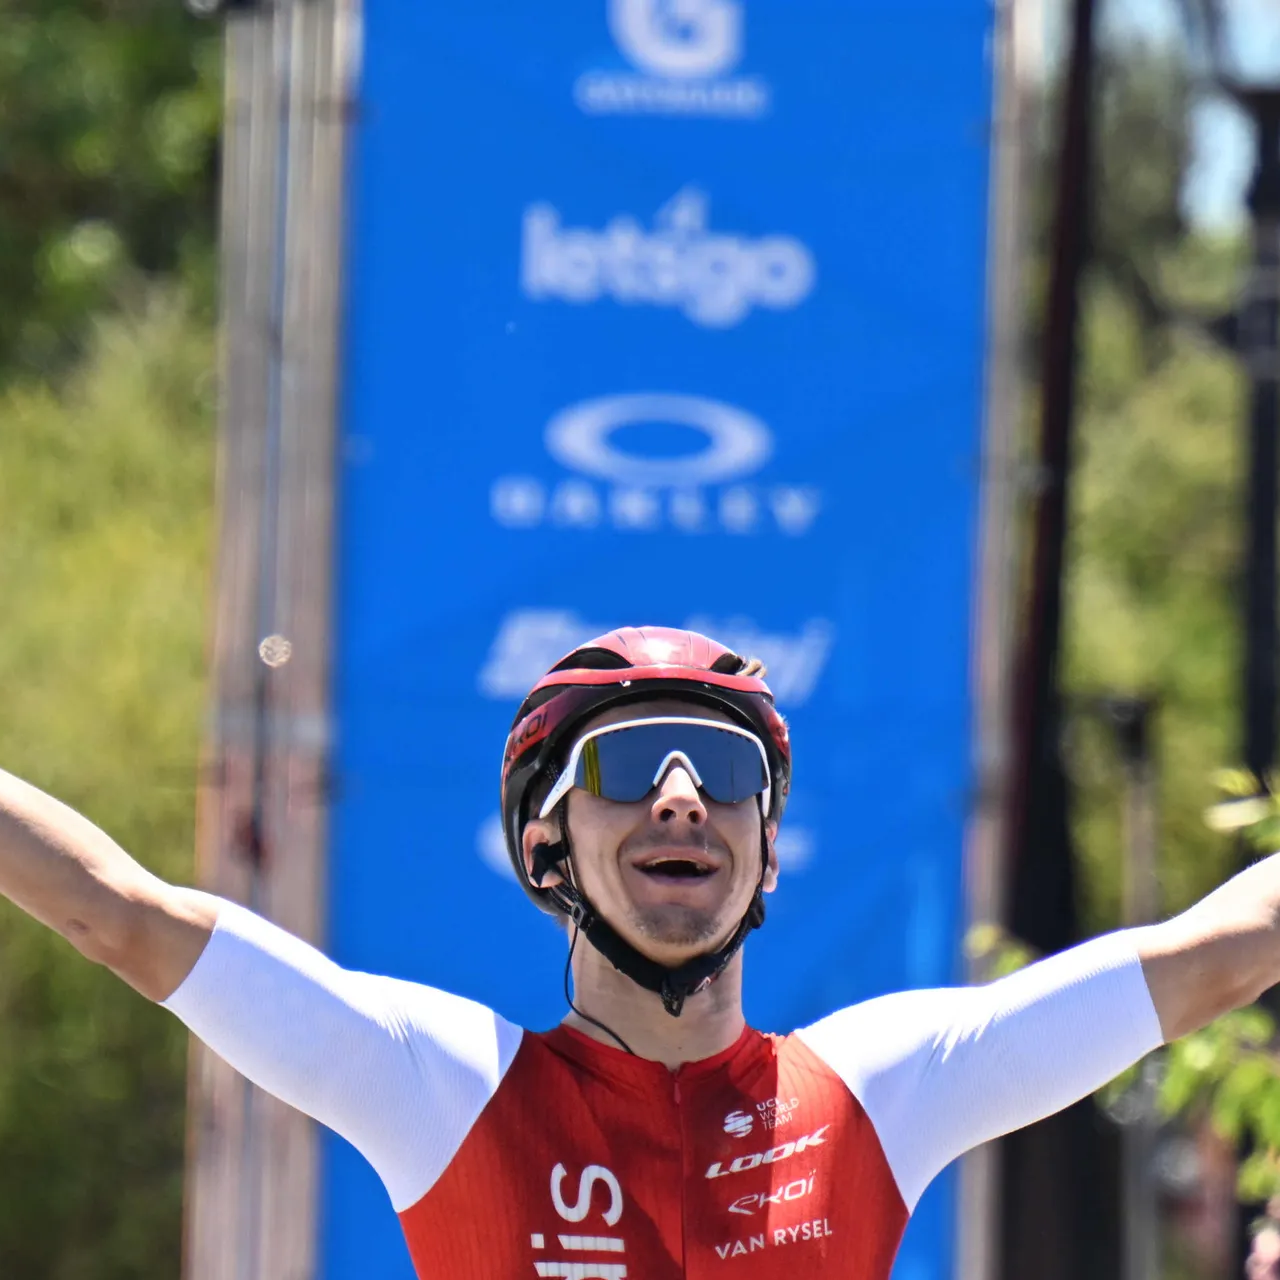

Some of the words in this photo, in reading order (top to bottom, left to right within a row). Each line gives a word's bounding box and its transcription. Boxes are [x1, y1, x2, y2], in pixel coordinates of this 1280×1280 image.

[759, 1098, 800, 1120] WORLD
[763, 1113, 793, 1131] TEAM
[705, 1124, 832, 1179] LOOK
[715, 1234, 765, 1260] VAN
[773, 1218, 833, 1247] RYSEL
